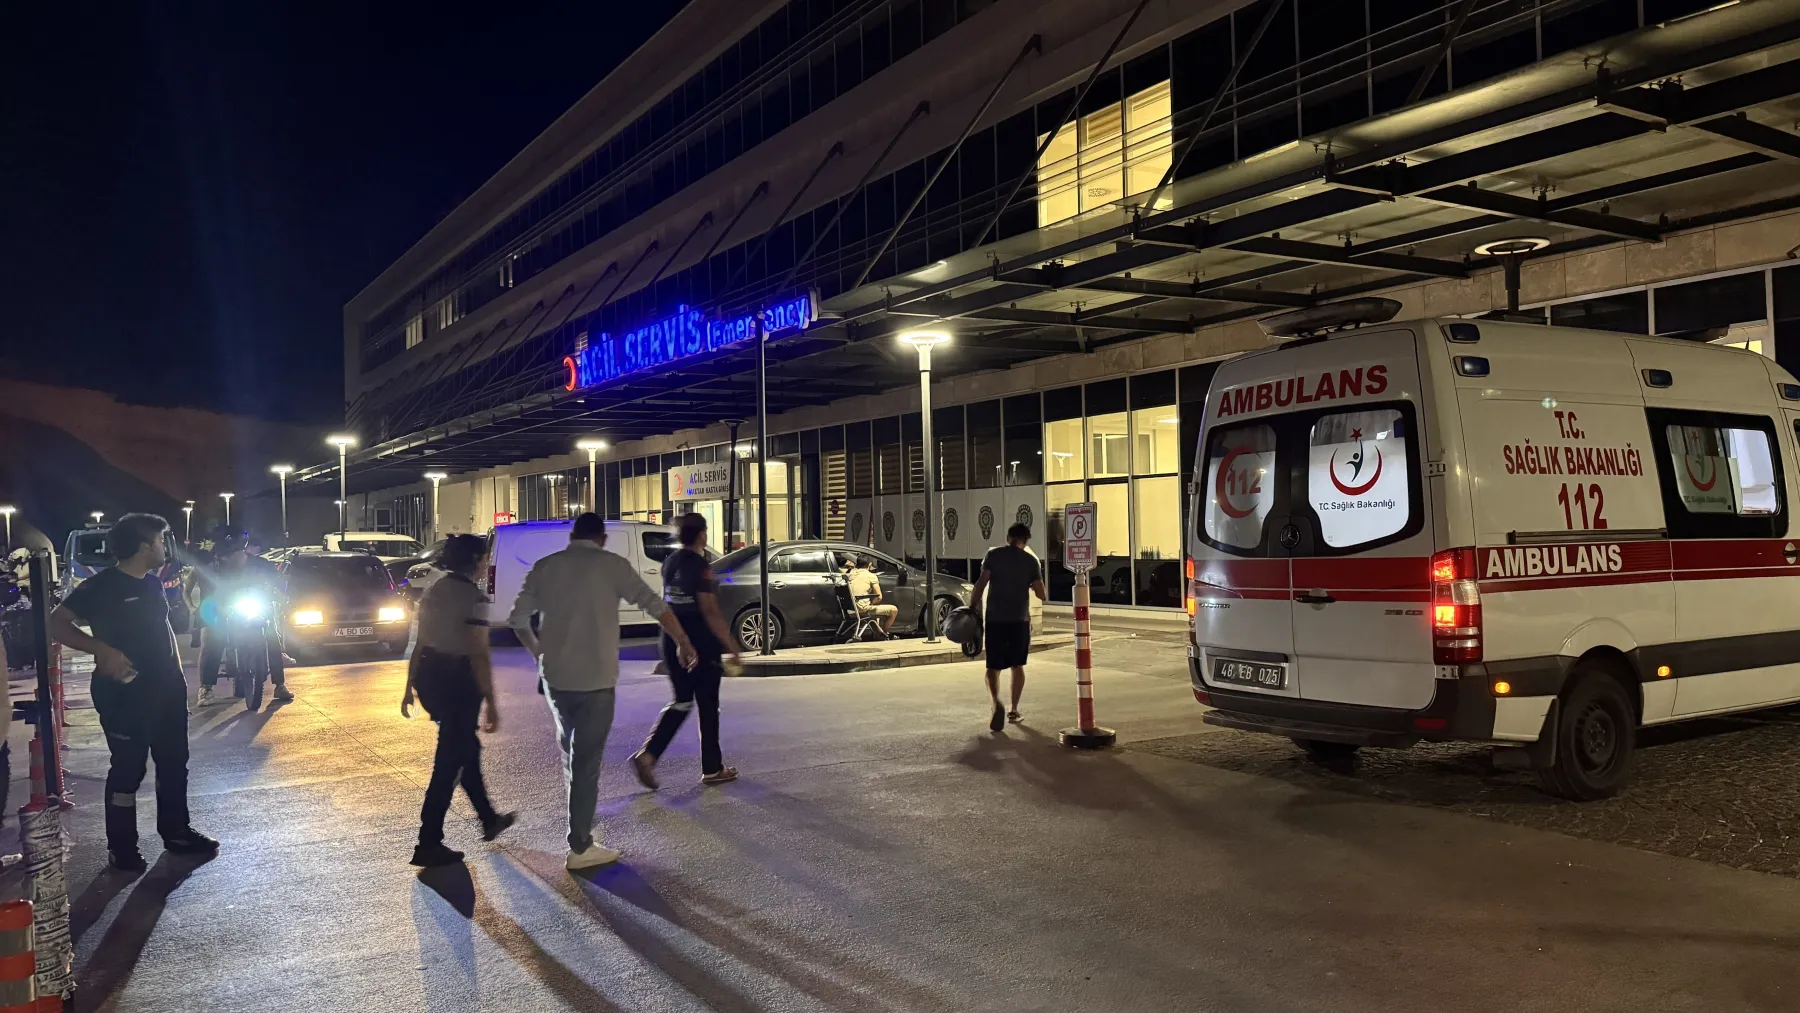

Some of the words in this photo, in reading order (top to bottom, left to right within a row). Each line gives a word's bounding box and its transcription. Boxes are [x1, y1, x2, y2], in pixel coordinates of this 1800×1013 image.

[580, 332, 621, 388] ACİL
[625, 304, 701, 369] SERVİS
[1217, 364, 1388, 418] AMBULANS
[1554, 411, 1585, 439] T.C.
[1503, 438, 1564, 475] SAĞLIK
[1564, 442, 1643, 476] BAKANLIĞI
[689, 470, 703, 484] ACİL
[704, 467, 727, 482] SERVİS
[1227, 469, 1261, 496] 112
[1331, 501, 1355, 512] Sağlık
[1357, 499, 1396, 510] Bakanlığı
[1558, 483, 1608, 529] 112
[1486, 544, 1622, 578] AMBULANS
[1221, 663, 1234, 678] 48
[1239, 664, 1254, 680] EB
